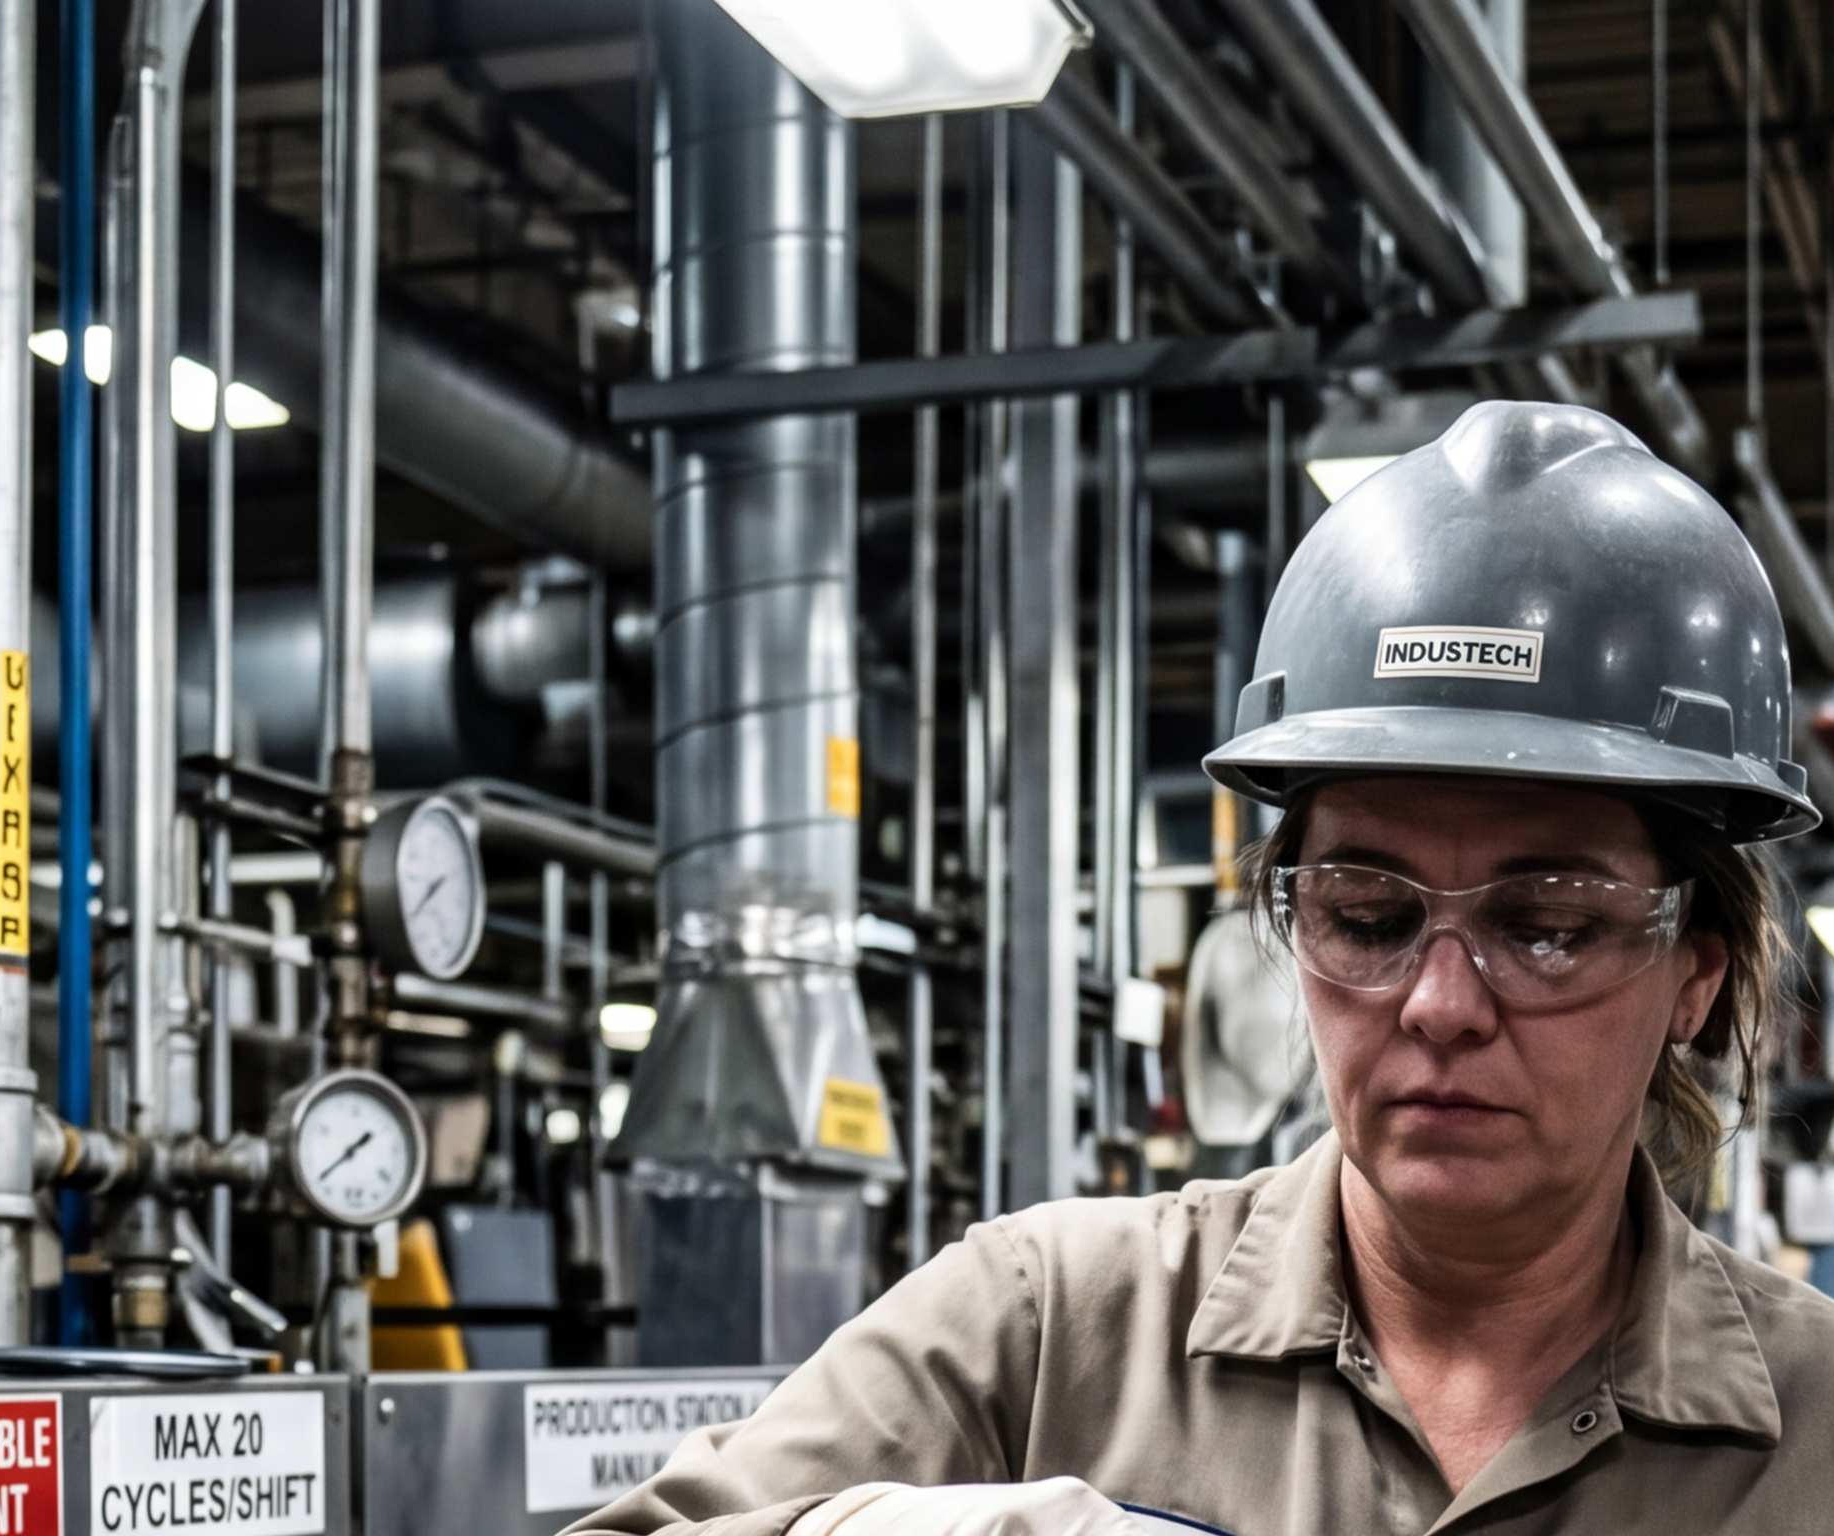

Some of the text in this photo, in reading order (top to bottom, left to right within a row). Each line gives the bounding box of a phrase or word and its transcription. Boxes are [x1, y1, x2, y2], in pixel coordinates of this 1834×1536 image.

[1384, 641, 1533, 668] INDUSTECH
[155, 1412, 263, 1460] MAX 20
[101, 1473, 316, 1532] CYCLES/SHIFT
